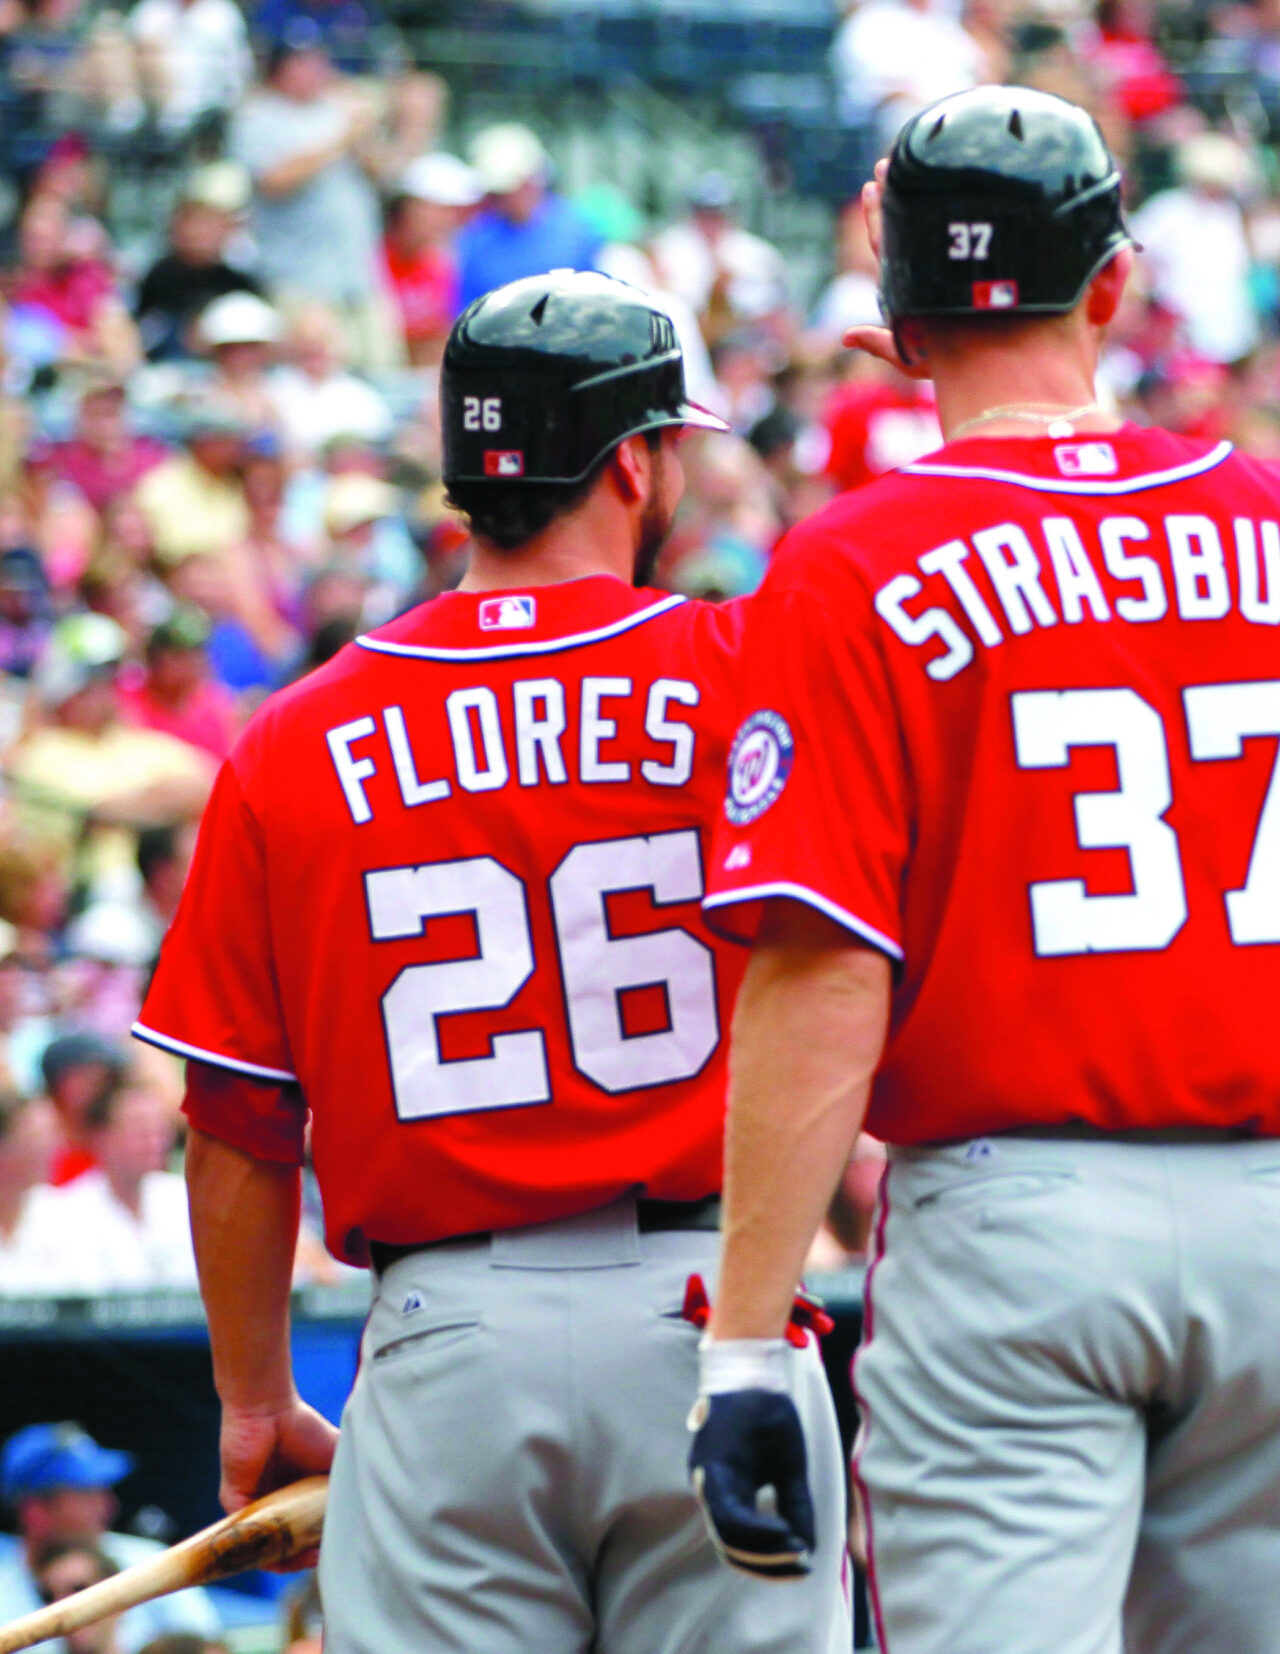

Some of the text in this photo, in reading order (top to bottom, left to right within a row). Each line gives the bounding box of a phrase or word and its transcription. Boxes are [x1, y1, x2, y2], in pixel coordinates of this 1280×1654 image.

[947, 222, 993, 260] 37
[463, 396, 501, 431] 26
[325, 676, 700, 823] FLORES
[364, 830, 719, 1120] 26
